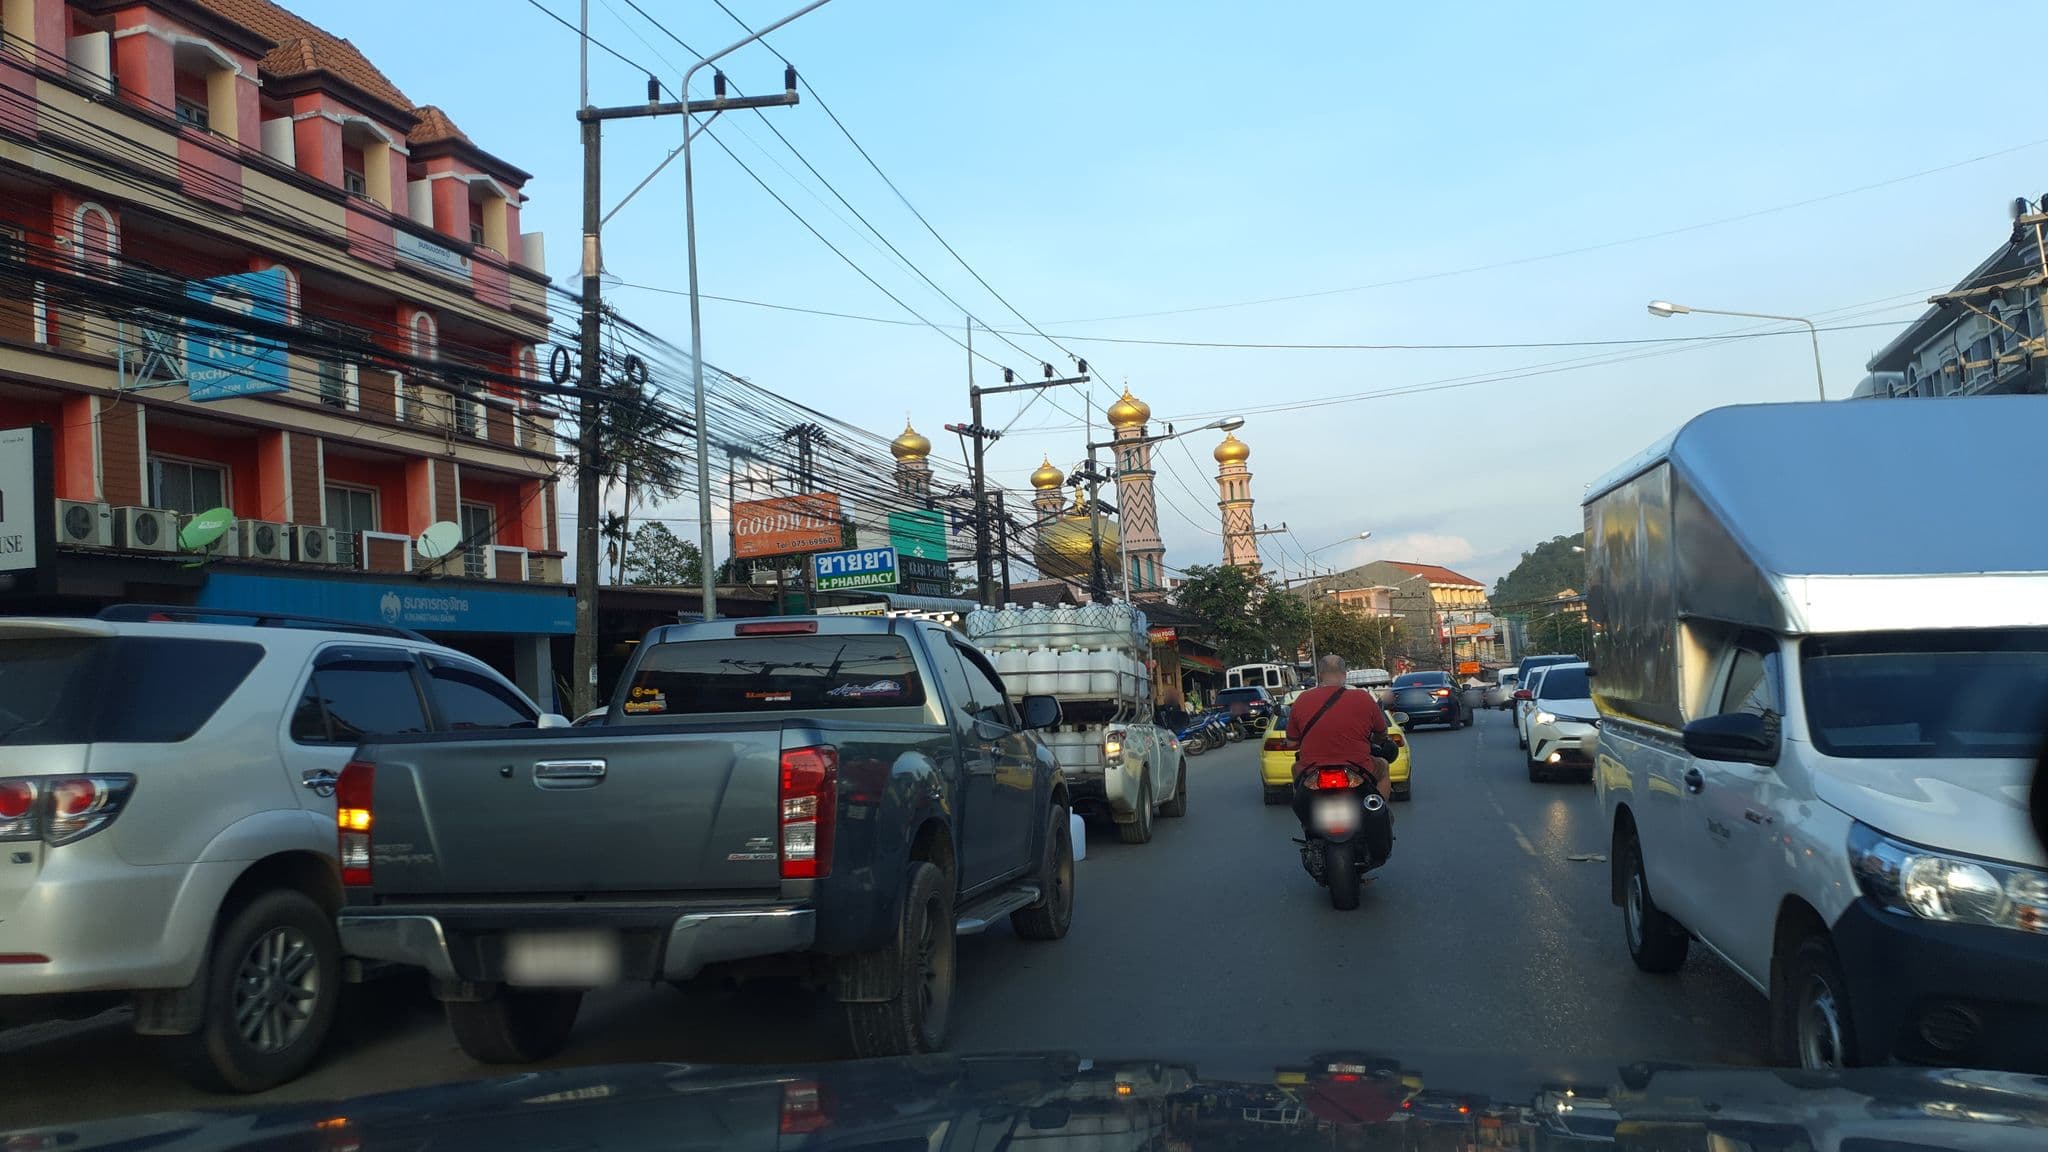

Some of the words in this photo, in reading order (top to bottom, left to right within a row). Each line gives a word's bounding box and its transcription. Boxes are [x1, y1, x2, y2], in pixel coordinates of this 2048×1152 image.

[736, 508, 837, 537] GOODWILL
[818, 550, 893, 574] ขายยา
[831, 572, 893, 588] PHARMACY
